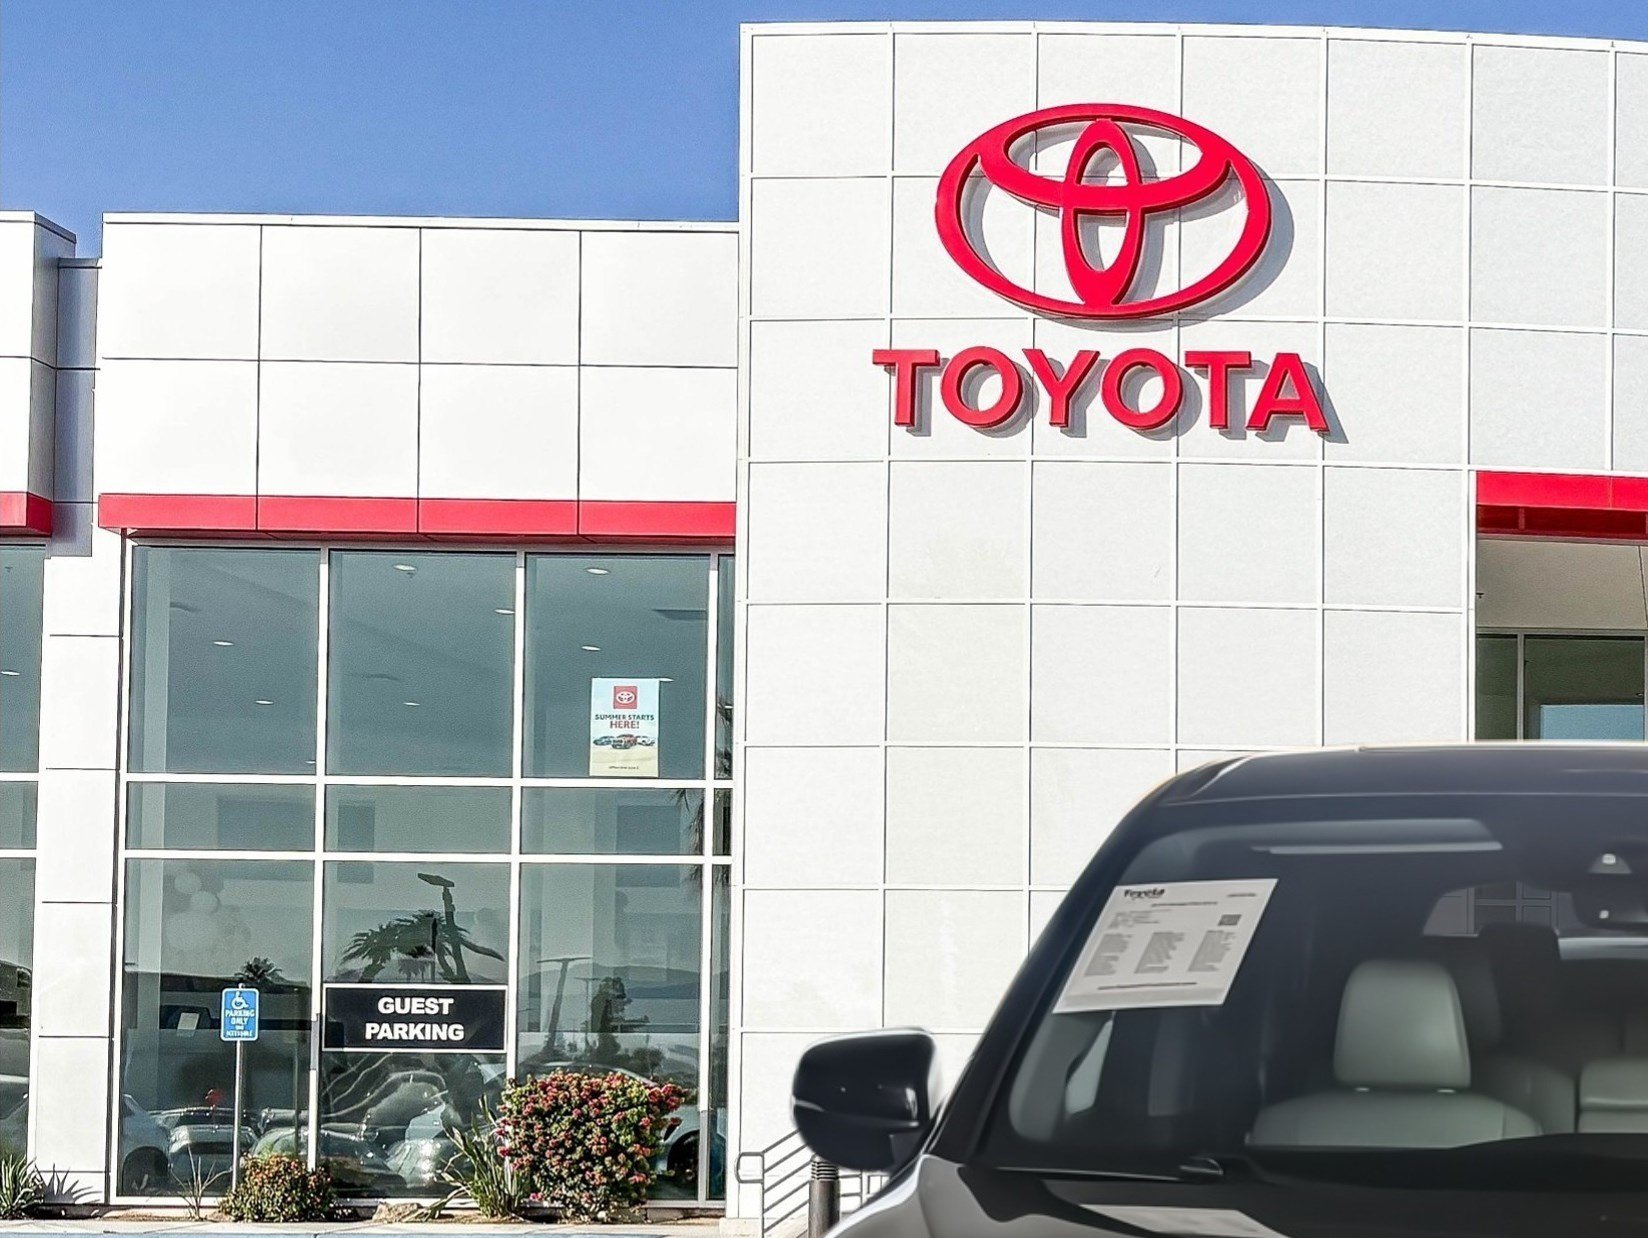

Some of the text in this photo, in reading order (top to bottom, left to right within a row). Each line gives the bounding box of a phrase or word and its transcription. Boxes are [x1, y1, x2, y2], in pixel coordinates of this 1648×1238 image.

[872, 346, 1330, 432] TOYOTA
[609, 720, 640, 729] HERE!
[225, 1009, 255, 1018] PARKING
[377, 996, 455, 1015] GUEST
[365, 1022, 465, 1042] PARKING
